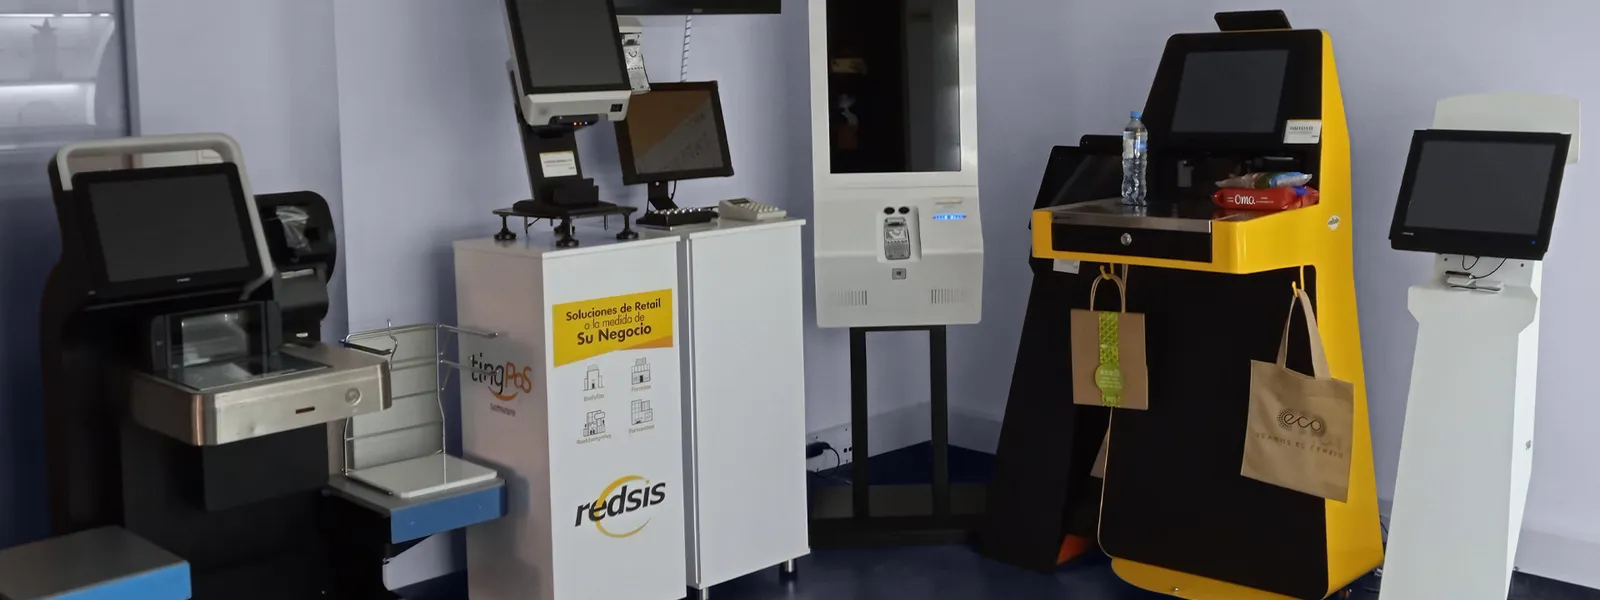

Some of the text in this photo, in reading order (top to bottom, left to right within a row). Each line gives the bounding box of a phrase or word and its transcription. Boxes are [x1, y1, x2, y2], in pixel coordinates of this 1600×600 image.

[566, 298, 661, 321] Soluciones de Retail
[593, 319, 600, 329] la
[602, 314, 633, 326] medida
[634, 312, 645, 322] de
[577, 323, 652, 345] Su Negocio
[1284, 413, 1322, 432] eco
[574, 479, 666, 527] redsis
